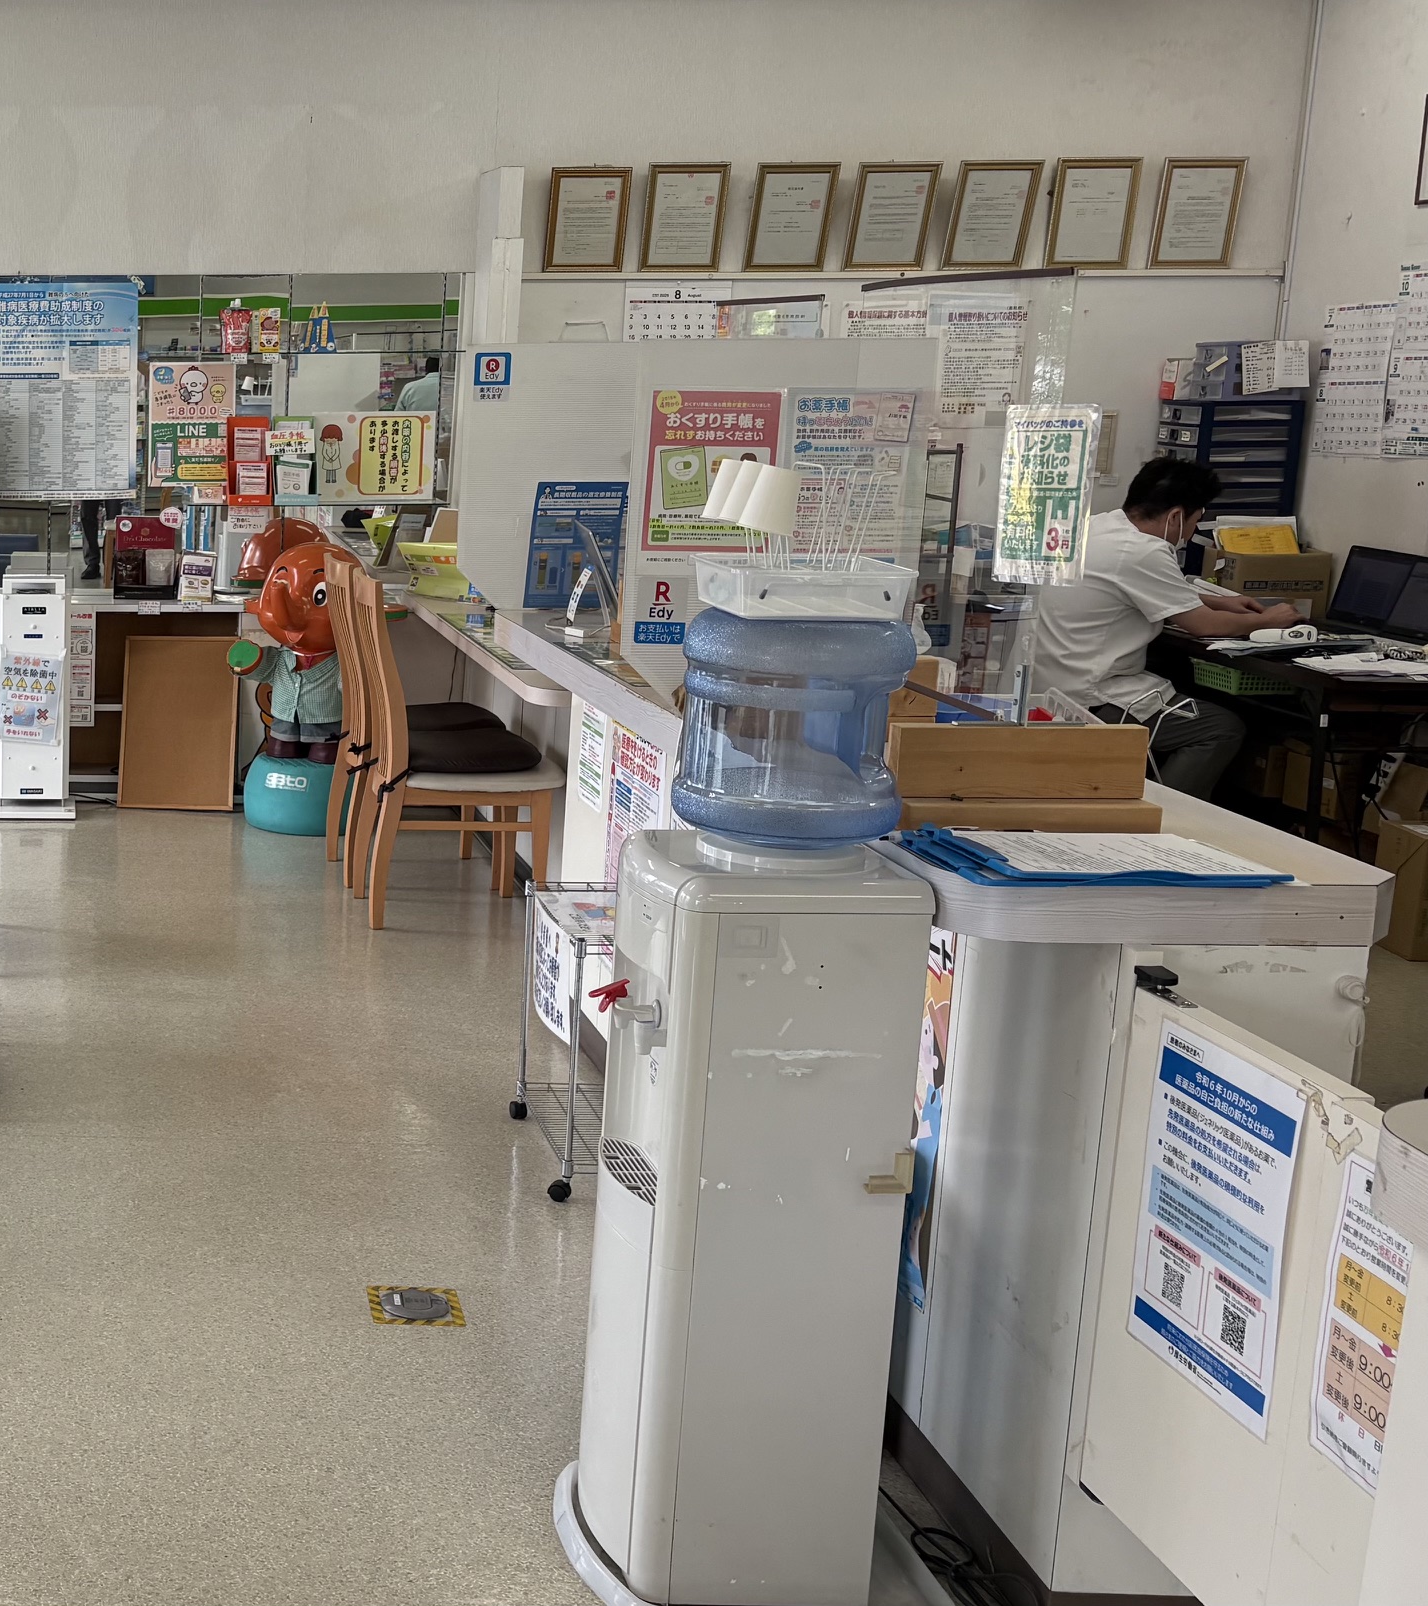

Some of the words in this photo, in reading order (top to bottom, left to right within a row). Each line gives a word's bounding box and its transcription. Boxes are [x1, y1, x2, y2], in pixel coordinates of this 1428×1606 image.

[1402, 281, 1410, 291] 10
[674, 290, 682, 300] 8
[1328, 314, 1333, 324] 7
[489, 361, 496, 370] R
[1393, 364, 1399, 373] 9
[484, 373, 500, 381] Edy
[798, 398, 850, 412] お薬手帳
[666, 413, 765, 428] おくすり手帳を
[177, 425, 207, 436] LINE
[271, 431, 305, 440] 血圧手帳
[665, 431, 763, 440] 忘れずお持ちください
[368, 421, 377, 452] あります
[1046, 527, 1060, 551] 3
[1061, 540, 1070, 549] 円
[656, 581, 671, 602] R
[649, 607, 673, 620] Edy
[639, 624, 680, 632] お支払いは
[637, 633, 680, 642] 楽天Edyで
[13, 656, 51, 667] 紫外線で
[4, 666, 57, 679] 空気を除菌中
[11, 693, 43, 702] のぞかない
[6, 729, 41, 737] 手をいれない
[1195, 1071, 1258, 1115] 令和6年10月からの
[1174, 1073, 1275, 1141] 医薬品の自己負担の新たな仕組み
[1332, 1325, 1357, 1353] 月〜金
[1330, 1345, 1355, 1372] 変更後
[1359, 1354, 1391, 1389] 9:00
[1335, 1371, 1343, 1386] 土
[1326, 1383, 1349, 1411] 変更後
[1353, 1393, 1386, 1429] 9:00
